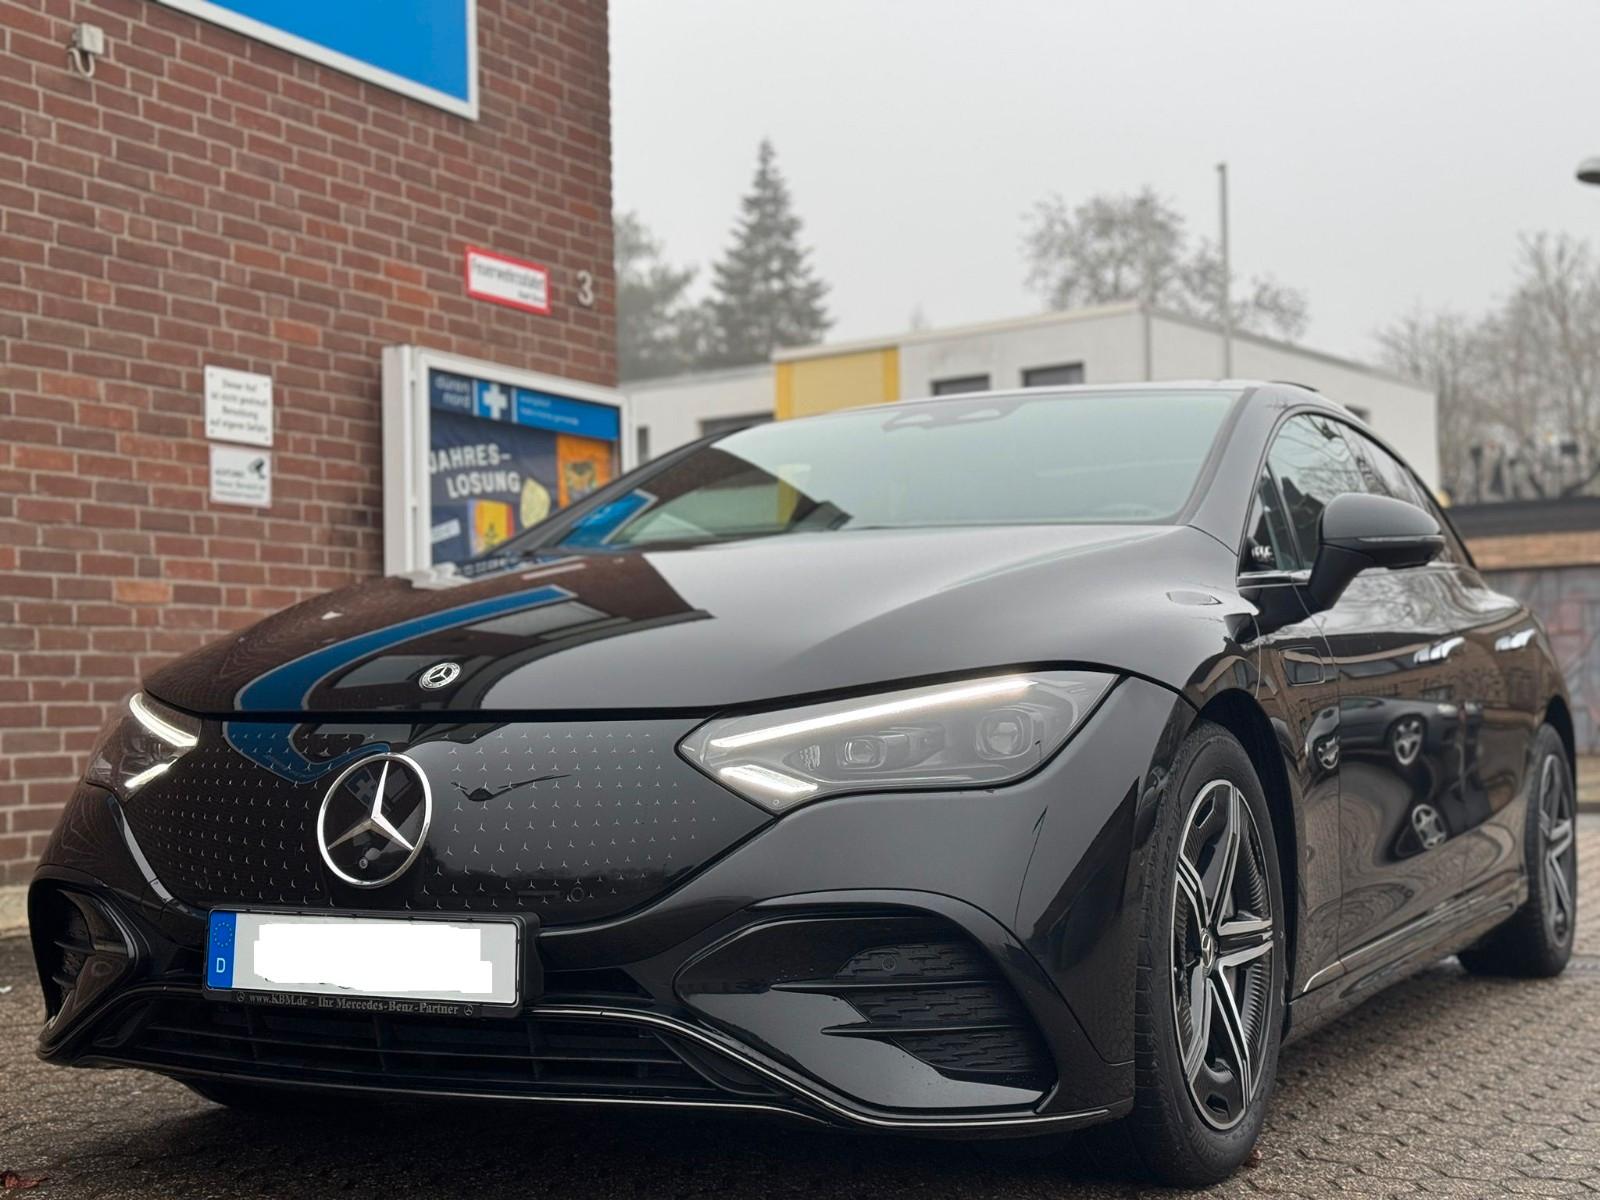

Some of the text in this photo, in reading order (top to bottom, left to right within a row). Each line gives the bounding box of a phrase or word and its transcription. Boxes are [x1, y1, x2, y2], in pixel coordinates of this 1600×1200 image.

[576, 269, 594, 306] 3
[445, 471, 520, 498] LOSUNG
[215, 957, 226, 973] D
